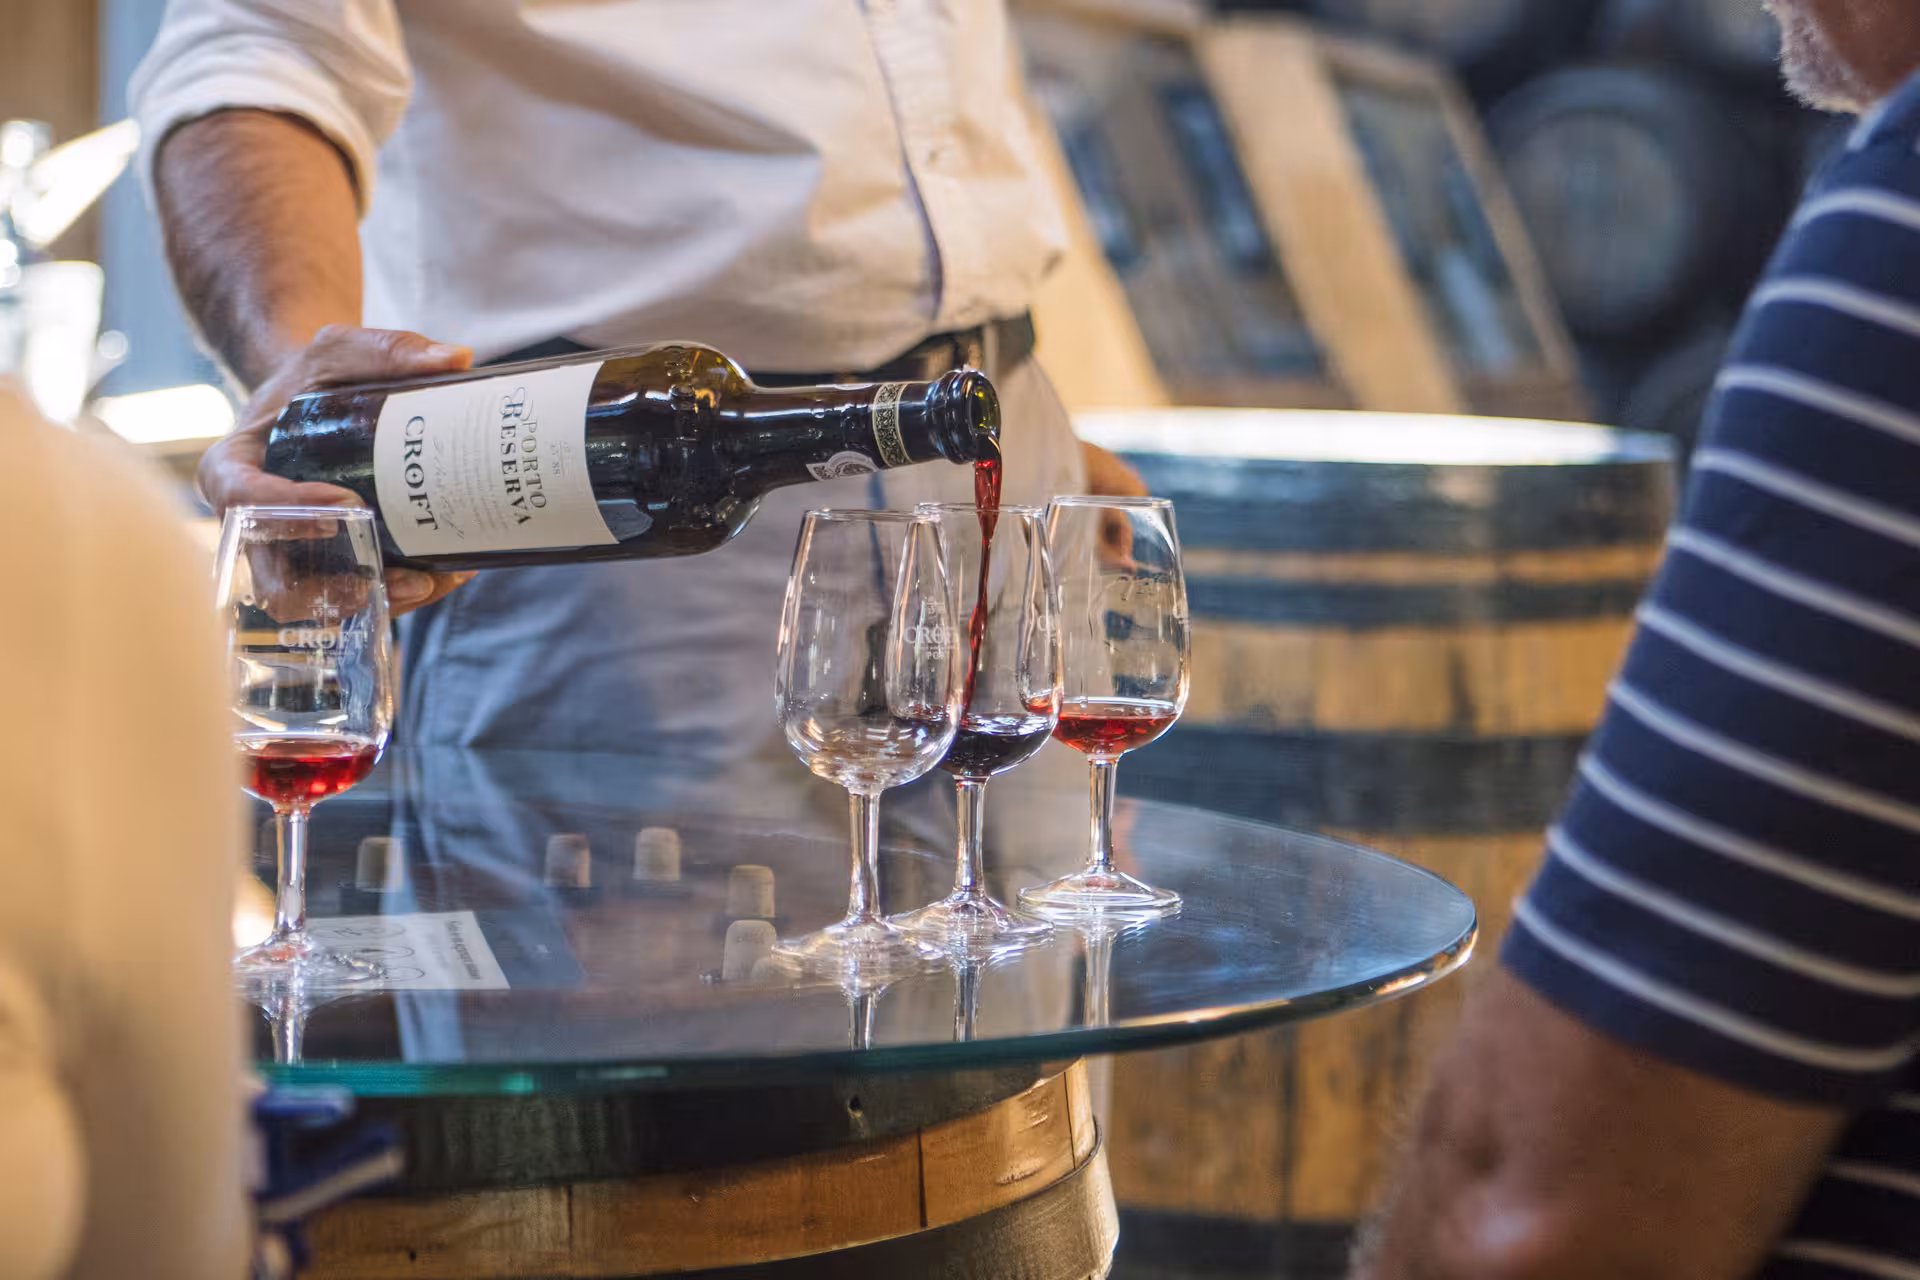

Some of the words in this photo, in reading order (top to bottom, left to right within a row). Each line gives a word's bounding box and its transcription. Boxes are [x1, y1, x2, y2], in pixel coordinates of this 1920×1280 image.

[403, 415, 439, 531] CROFT
[499, 386, 532, 526] RESERVA
[520, 418, 547, 509] PORTO
[278, 628, 364, 649] CROFT
